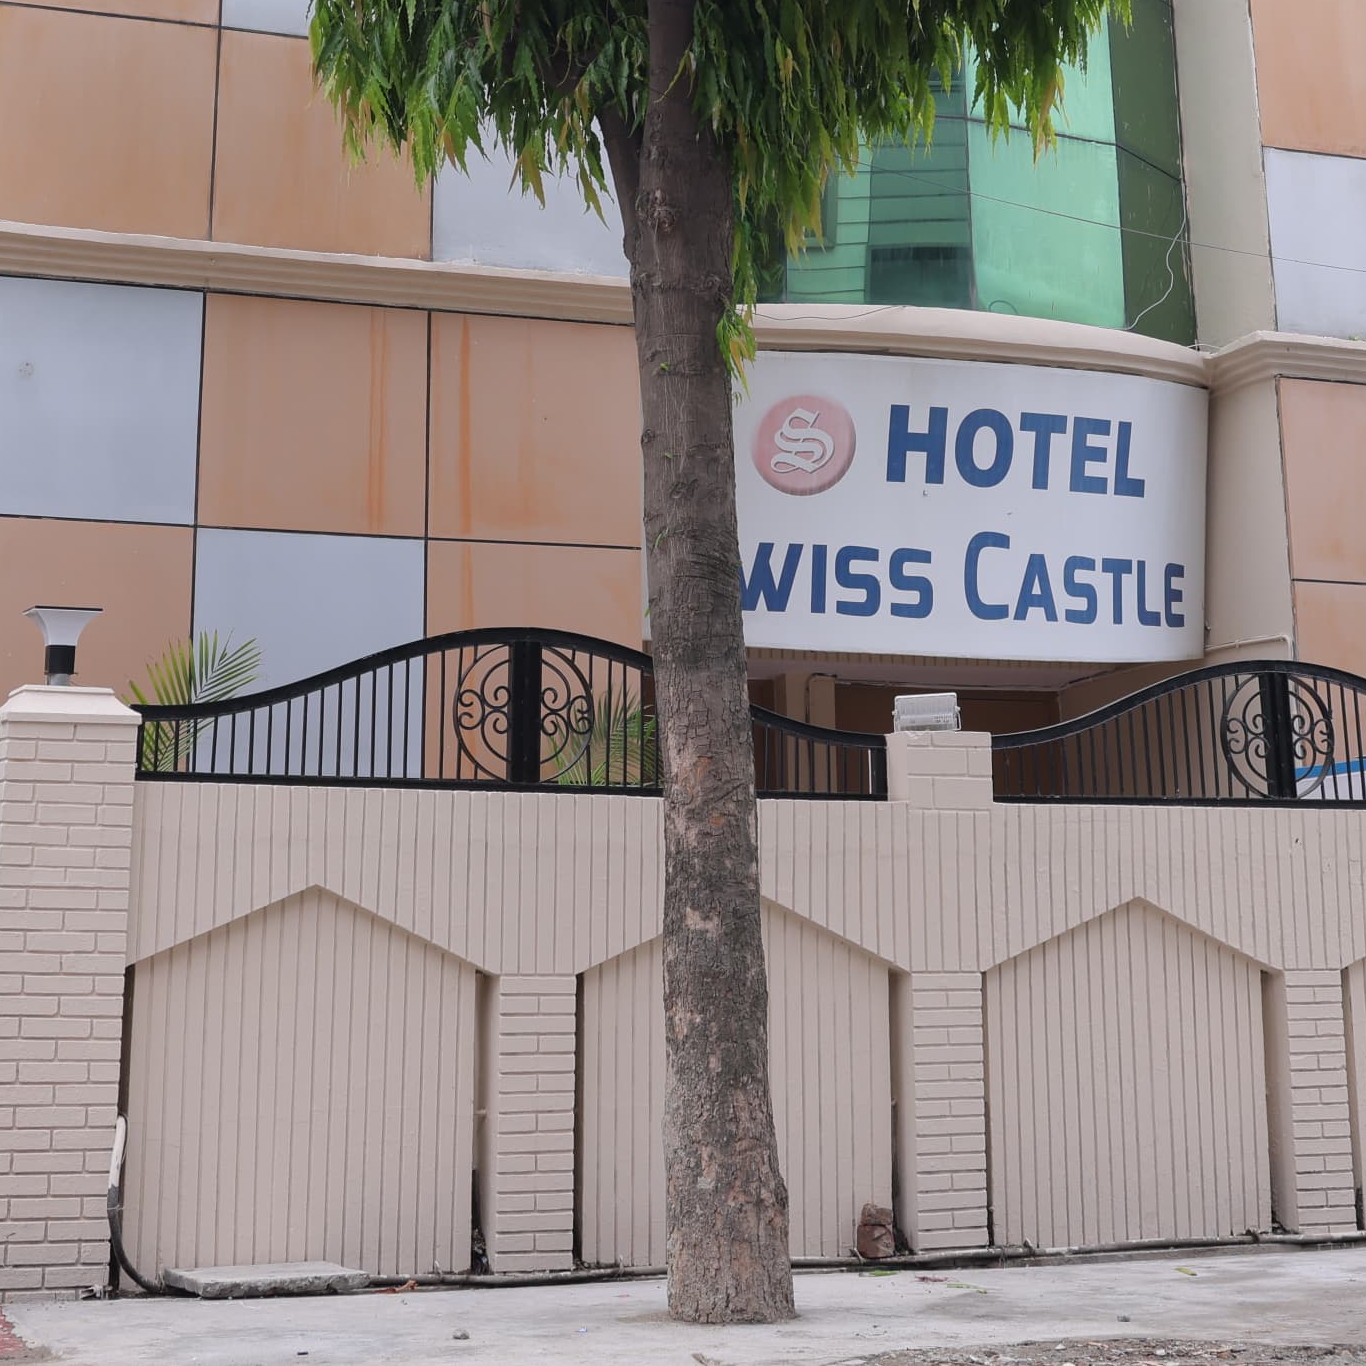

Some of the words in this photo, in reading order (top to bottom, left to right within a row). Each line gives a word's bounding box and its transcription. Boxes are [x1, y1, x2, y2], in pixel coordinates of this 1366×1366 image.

[886, 404, 1146, 498] HOTEL
[740, 542, 934, 619] WISS
[964, 531, 1185, 628] CASTLE
